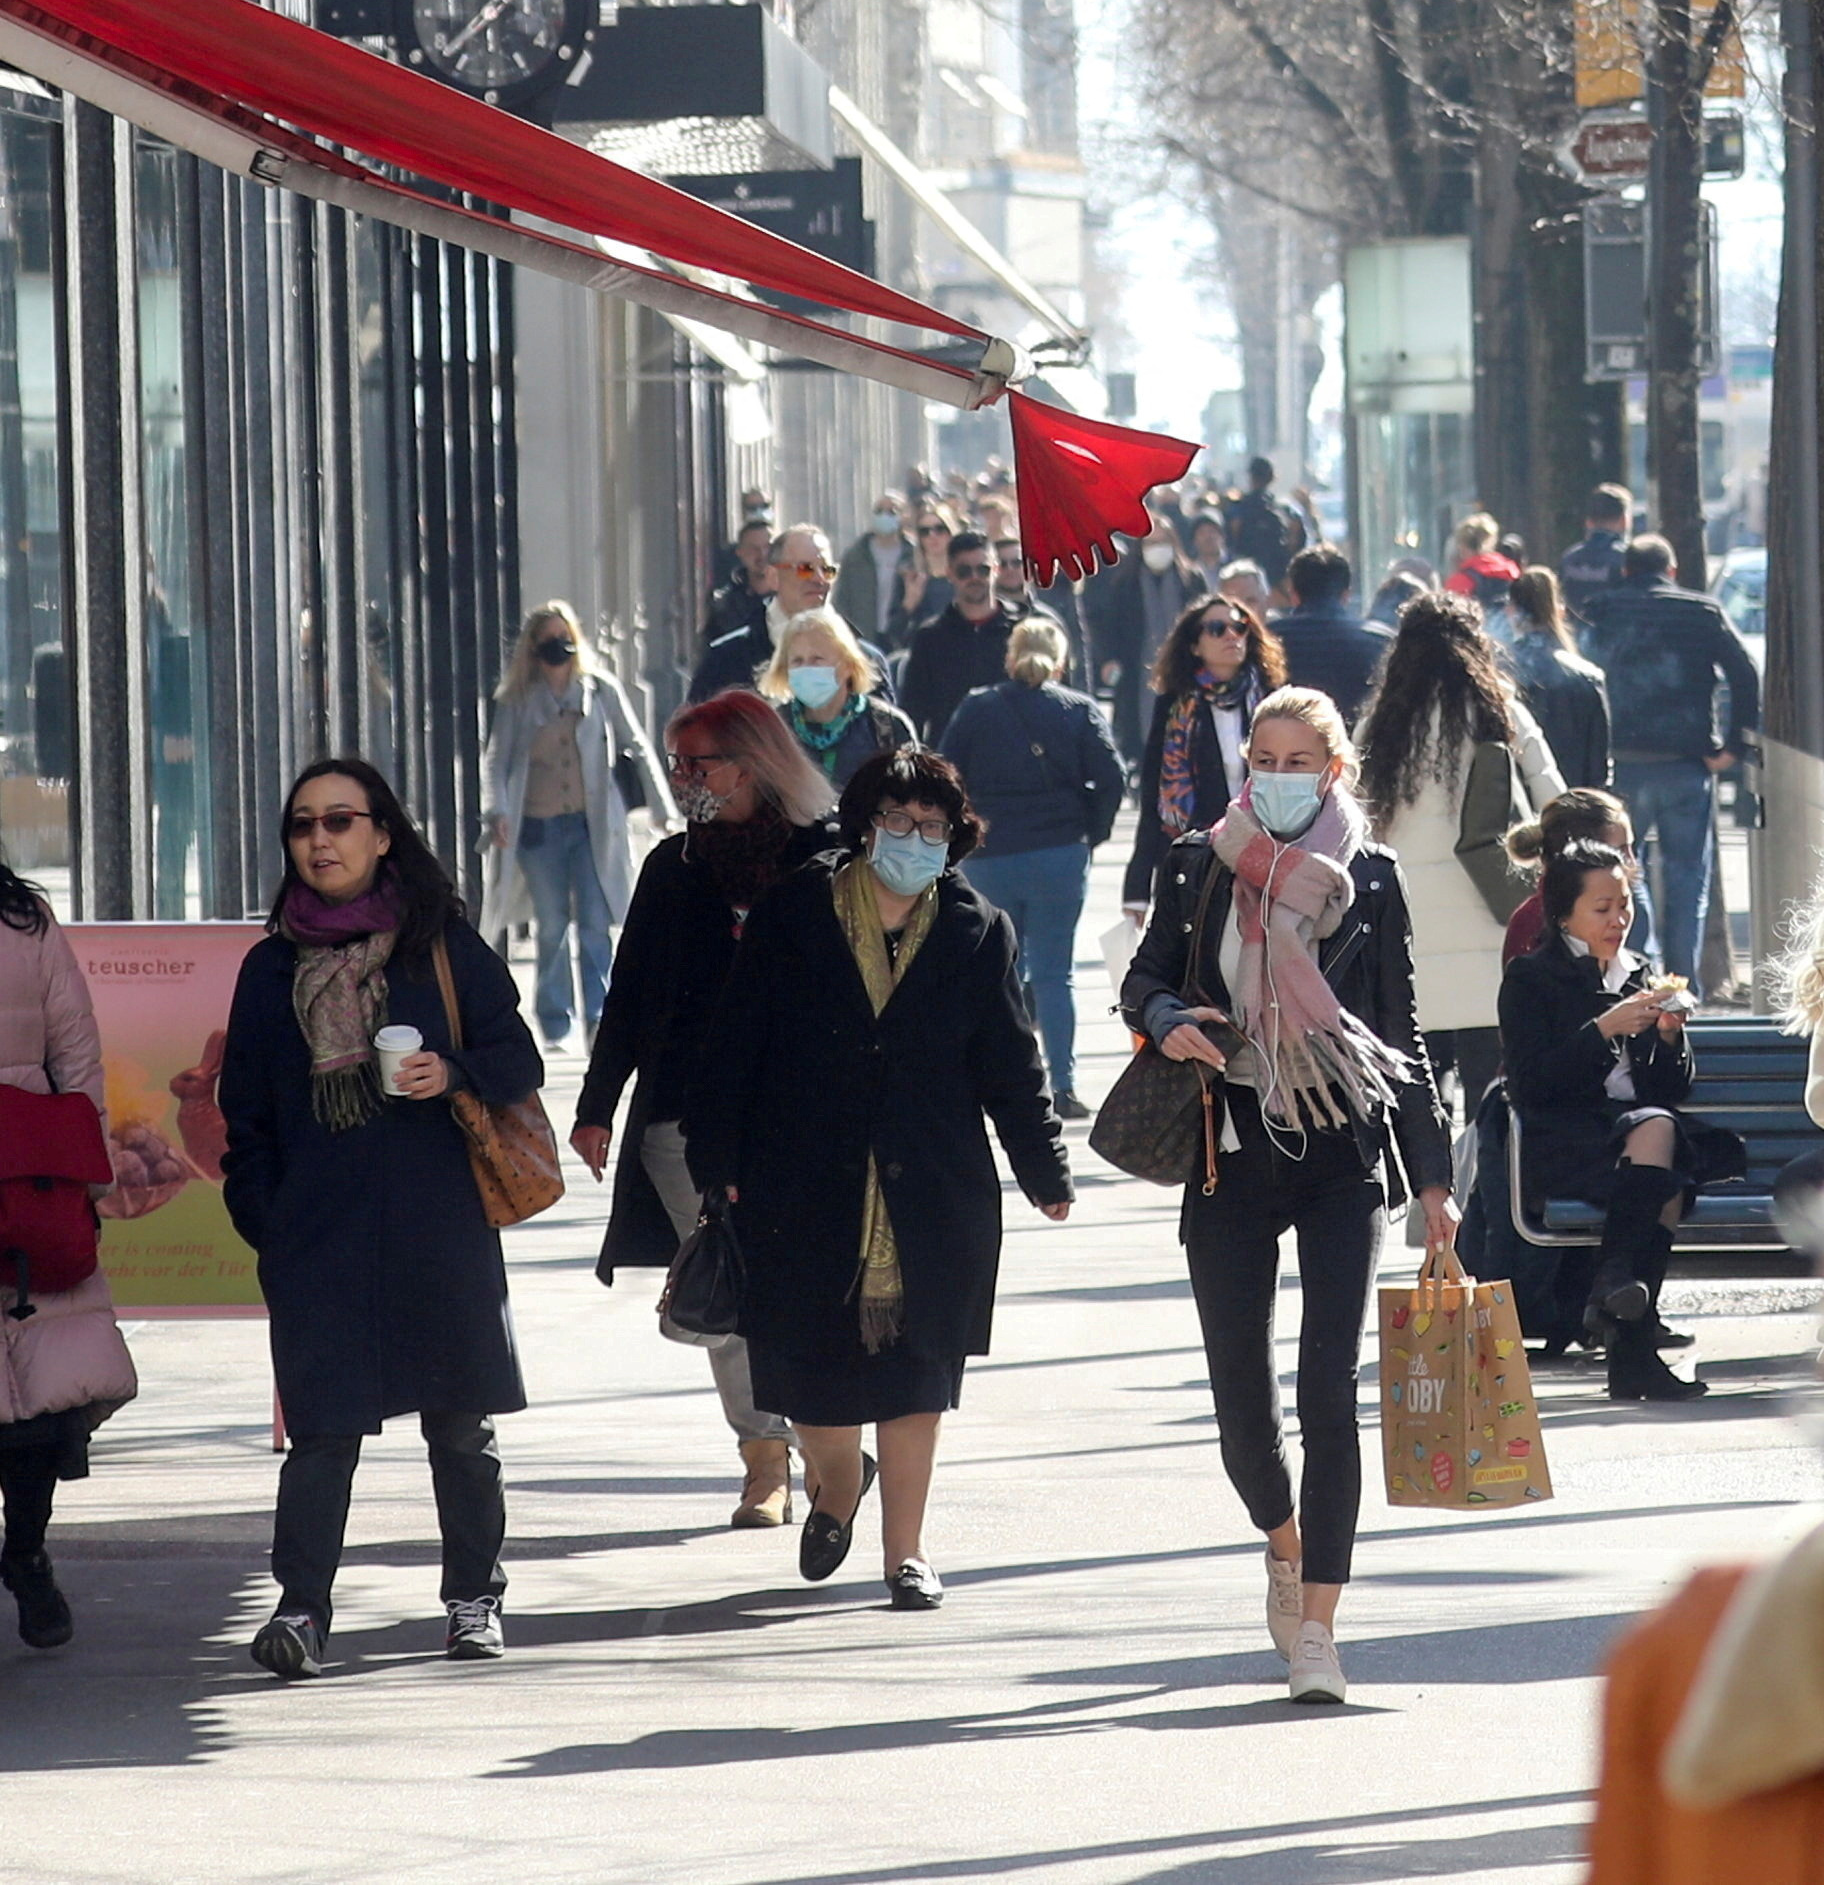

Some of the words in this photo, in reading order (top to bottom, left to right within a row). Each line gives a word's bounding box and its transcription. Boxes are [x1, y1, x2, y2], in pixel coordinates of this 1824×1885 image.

[533, 30, 546, 48] 4
[88, 959, 196, 975] teuscher
[146, 1241, 215, 1258] coming
[177, 1261, 209, 1277] der
